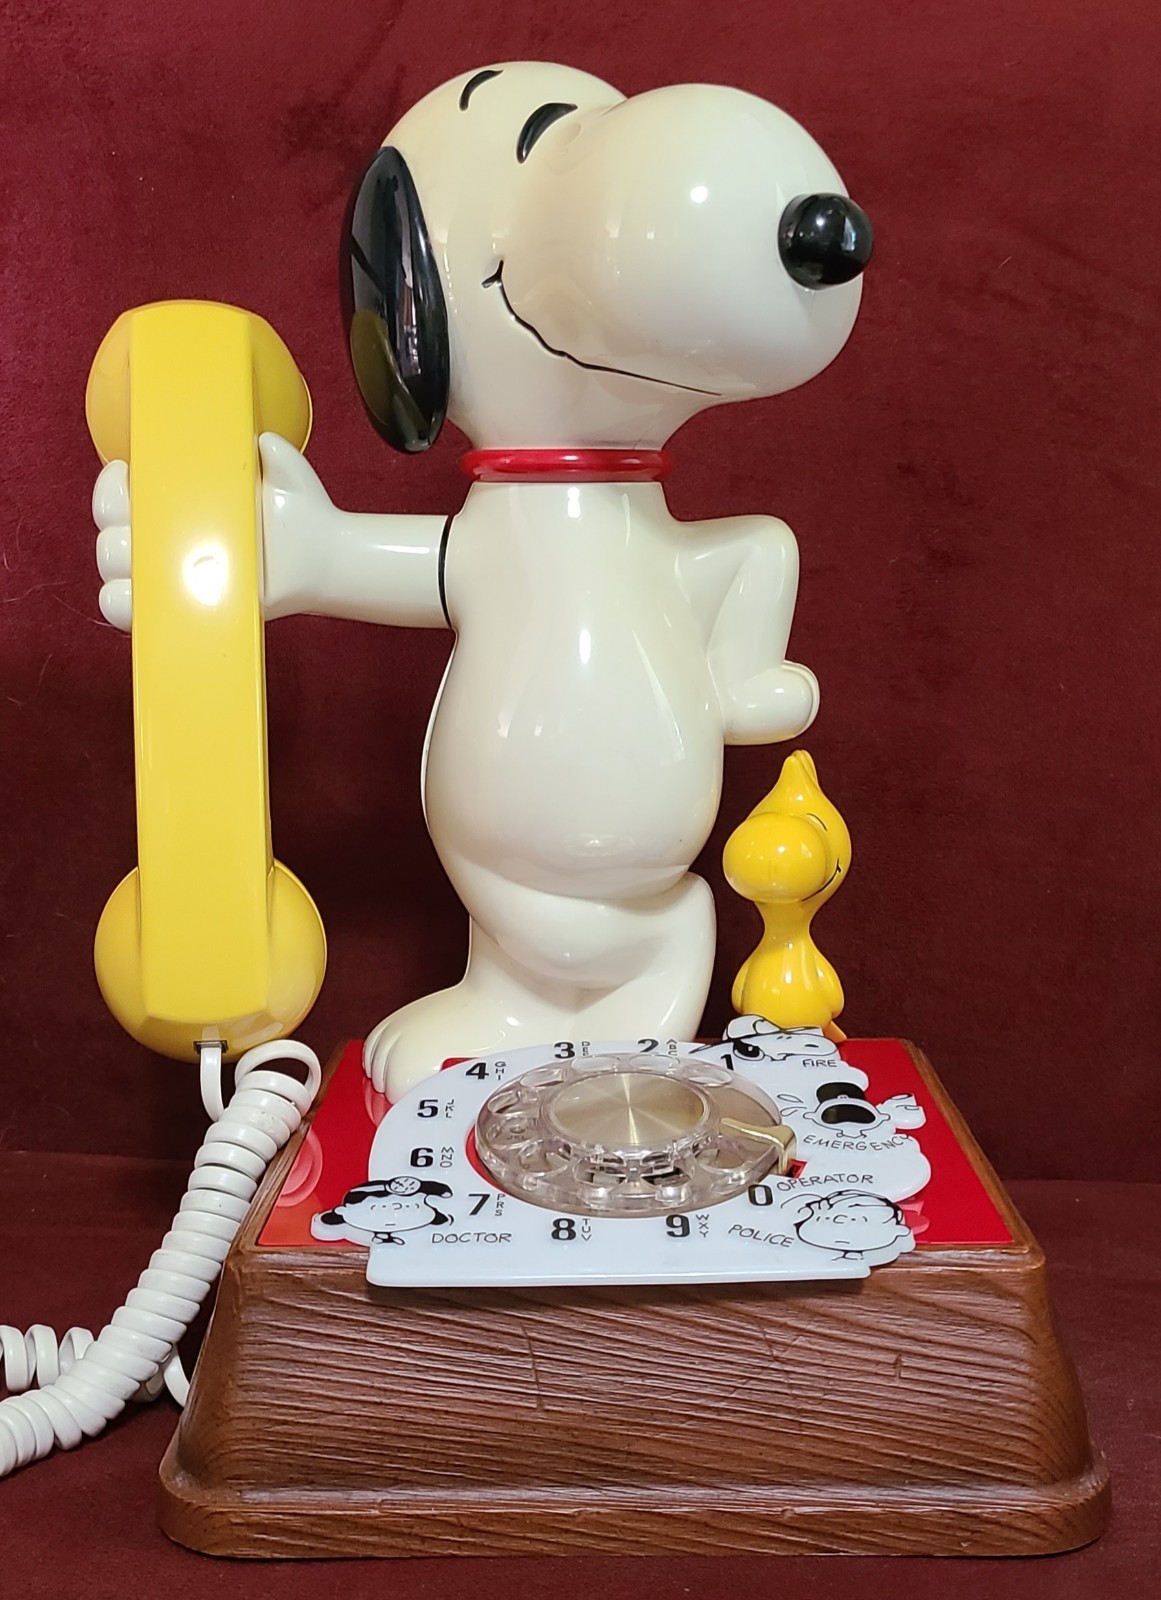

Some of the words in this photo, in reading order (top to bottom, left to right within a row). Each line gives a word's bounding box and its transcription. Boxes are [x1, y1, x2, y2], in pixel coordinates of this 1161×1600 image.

[553, 1041, 576, 1059] 3
[638, 1038, 659, 1053] 2
[465, 1062, 490, 1080] 4
[720, 1054, 734, 1071] 1
[802, 1058, 838, 1068] FIRE
[417, 1099, 439, 1118] 5
[410, 1147, 434, 1168] 6
[776, 1173, 874, 1191] OPERATOR
[468, 1193, 490, 1216] 7
[551, 1217, 576, 1241] 8
[665, 1214, 690, 1238] 9
[431, 1232, 512, 1244] DOCTOR
[728, 1224, 794, 1248] POLICE
